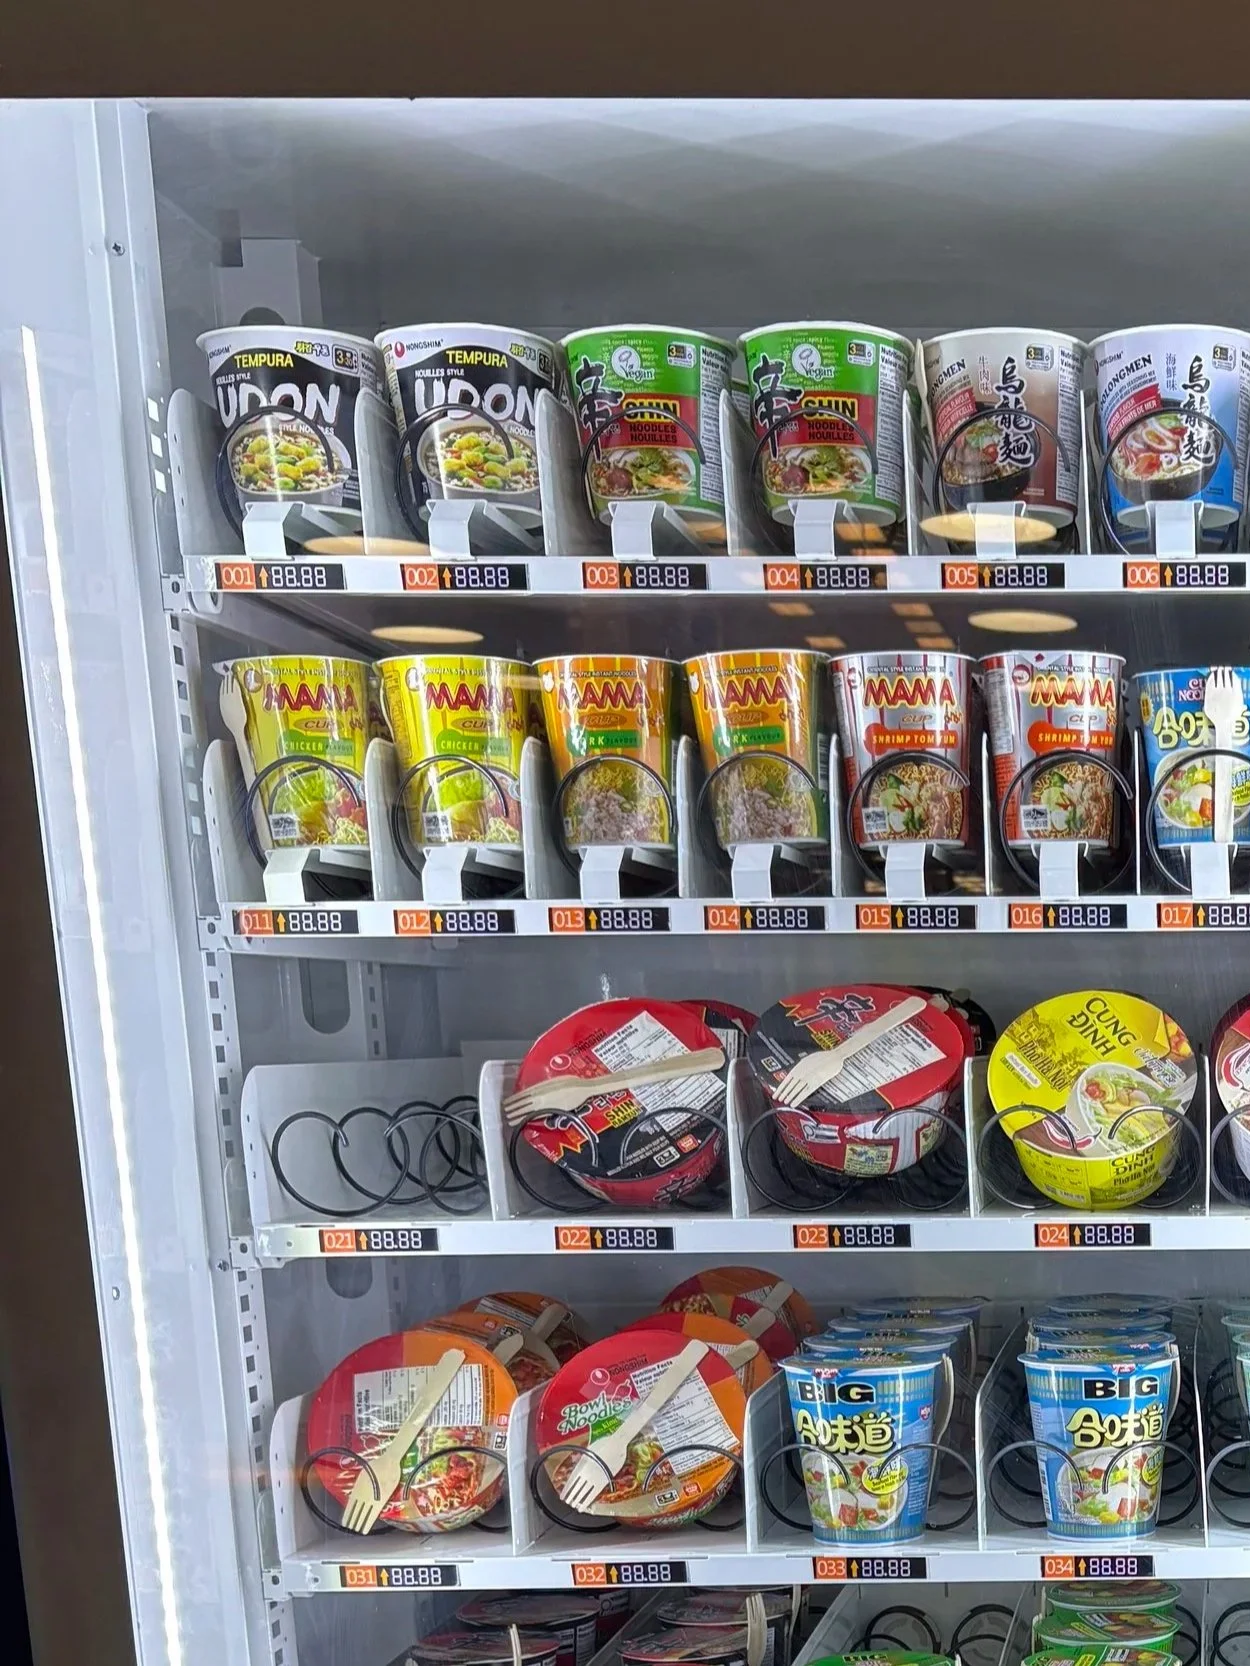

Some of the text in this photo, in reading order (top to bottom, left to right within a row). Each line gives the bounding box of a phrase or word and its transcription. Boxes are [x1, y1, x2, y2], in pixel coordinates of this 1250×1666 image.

[405, 339, 442, 352] NONGSHIM
[234, 354, 293, 369] TEMPURA
[446, 350, 508, 368] TEMPURA
[621, 364, 654, 381] Vegan
[804, 365, 834, 381] Vegan
[216, 382, 340, 429] UDON
[414, 378, 538, 425] UDON
[801, 398, 858, 420] SHIN
[629, 424, 677, 434] NOODLES
[807, 422, 855, 432] NOODLES
[630, 433, 677, 443] NOUILLES
[808, 431, 855, 441] NOUILLES
[222, 566, 254, 585] 001
[405, 567, 438, 586] 002
[586, 566, 618, 585] 003
[767, 567, 799, 585] 004
[946, 566, 977, 585] 005
[1127, 566, 1159, 585] 006
[262, 683, 359, 712] MAMA
[426, 681, 517, 712] MAMA
[704, 675, 796, 710] MAMA
[863, 675, 957, 708] MAMA
[1030, 674, 1116, 708] MAMA
[902, 714, 932, 724] CUP
[440, 739, 480, 750] CHICKEN
[872, 734, 956, 744] SHRIMP TOM YUM
[1037, 732, 1077, 743] SHRIMP
[284, 741, 323, 752] CHICKEN
[242, 913, 272, 930] 011
[399, 913, 430, 930] 012
[552, 911, 584, 928] 013
[708, 909, 740, 926] 014
[860, 908, 890, 924] 015
[1012, 907, 1042, 924] 016
[1161, 907, 1191, 924] 017
[1085, 997, 1138, 1048] CUNG
[604, 1099, 636, 1121] SHIN
[325, 1232, 354, 1248] 021
[559, 1229, 590, 1246] 022
[798, 1228, 828, 1244] 023
[1038, 1227, 1069, 1243] 024
[797, 1380, 876, 1404] BIG
[1083, 1377, 1160, 1400] BIG
[561, 1390, 607, 1419] Bowl
[557, 1397, 632, 1436] Noodles
[1066, 1403, 1165, 1448] 合味道
[576, 1565, 605, 1582] 032
[818, 1558, 846, 1575] 033
[1045, 1558, 1073, 1575] 034
[346, 1569, 376, 1586] 031
